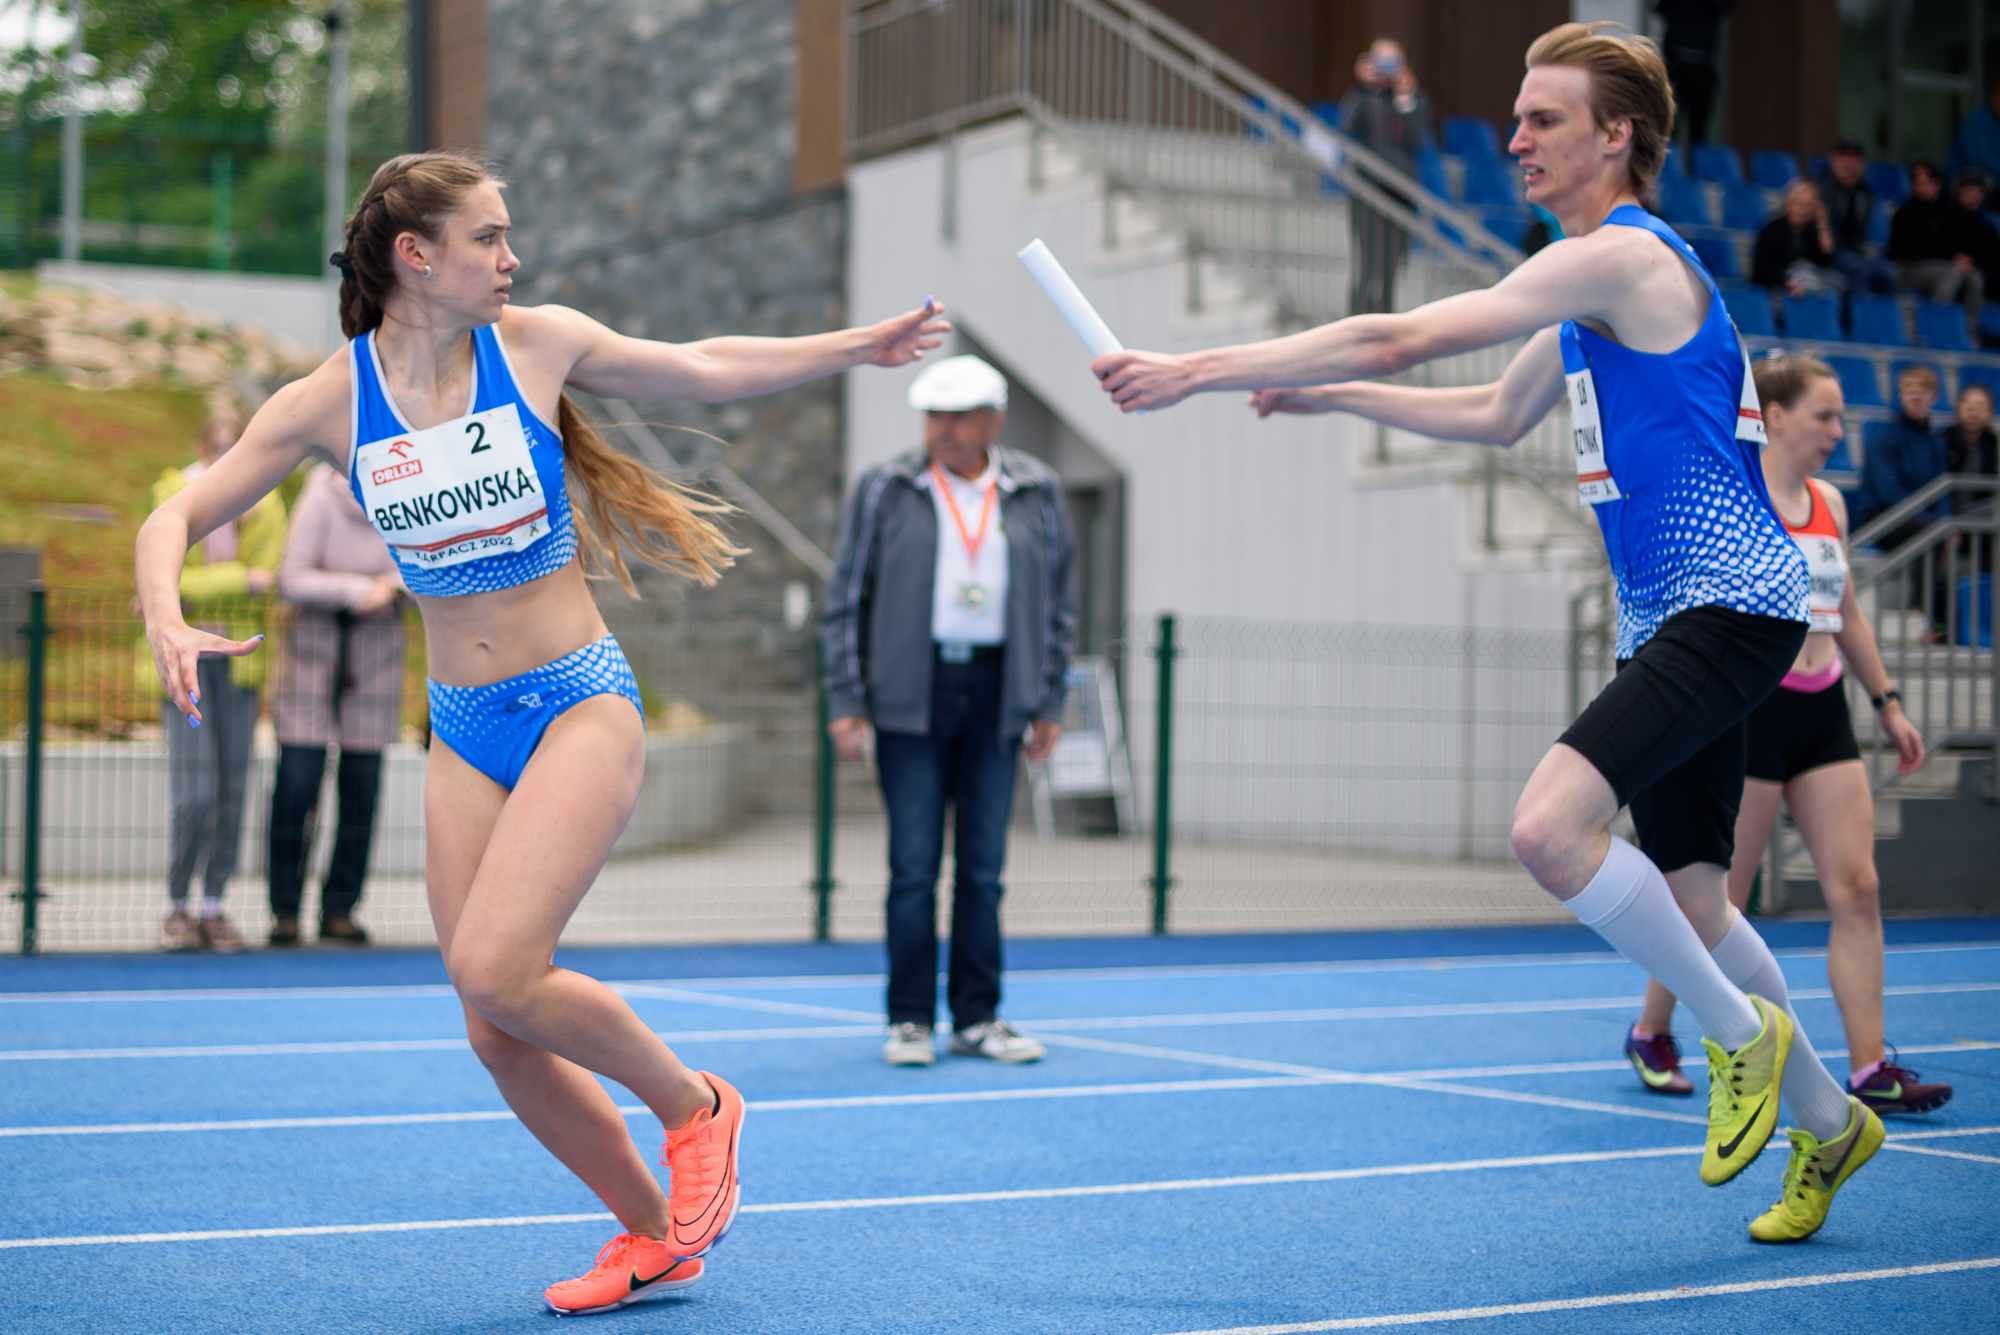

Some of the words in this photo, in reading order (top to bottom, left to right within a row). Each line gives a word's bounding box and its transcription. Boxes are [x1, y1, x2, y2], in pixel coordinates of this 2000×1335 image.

[1577, 376, 1588, 406] 18
[465, 421, 492, 455] 2
[374, 460, 421, 484] ORLEN
[374, 467, 536, 532] BENKOWSKA
[481, 535, 515, 549] 2022
